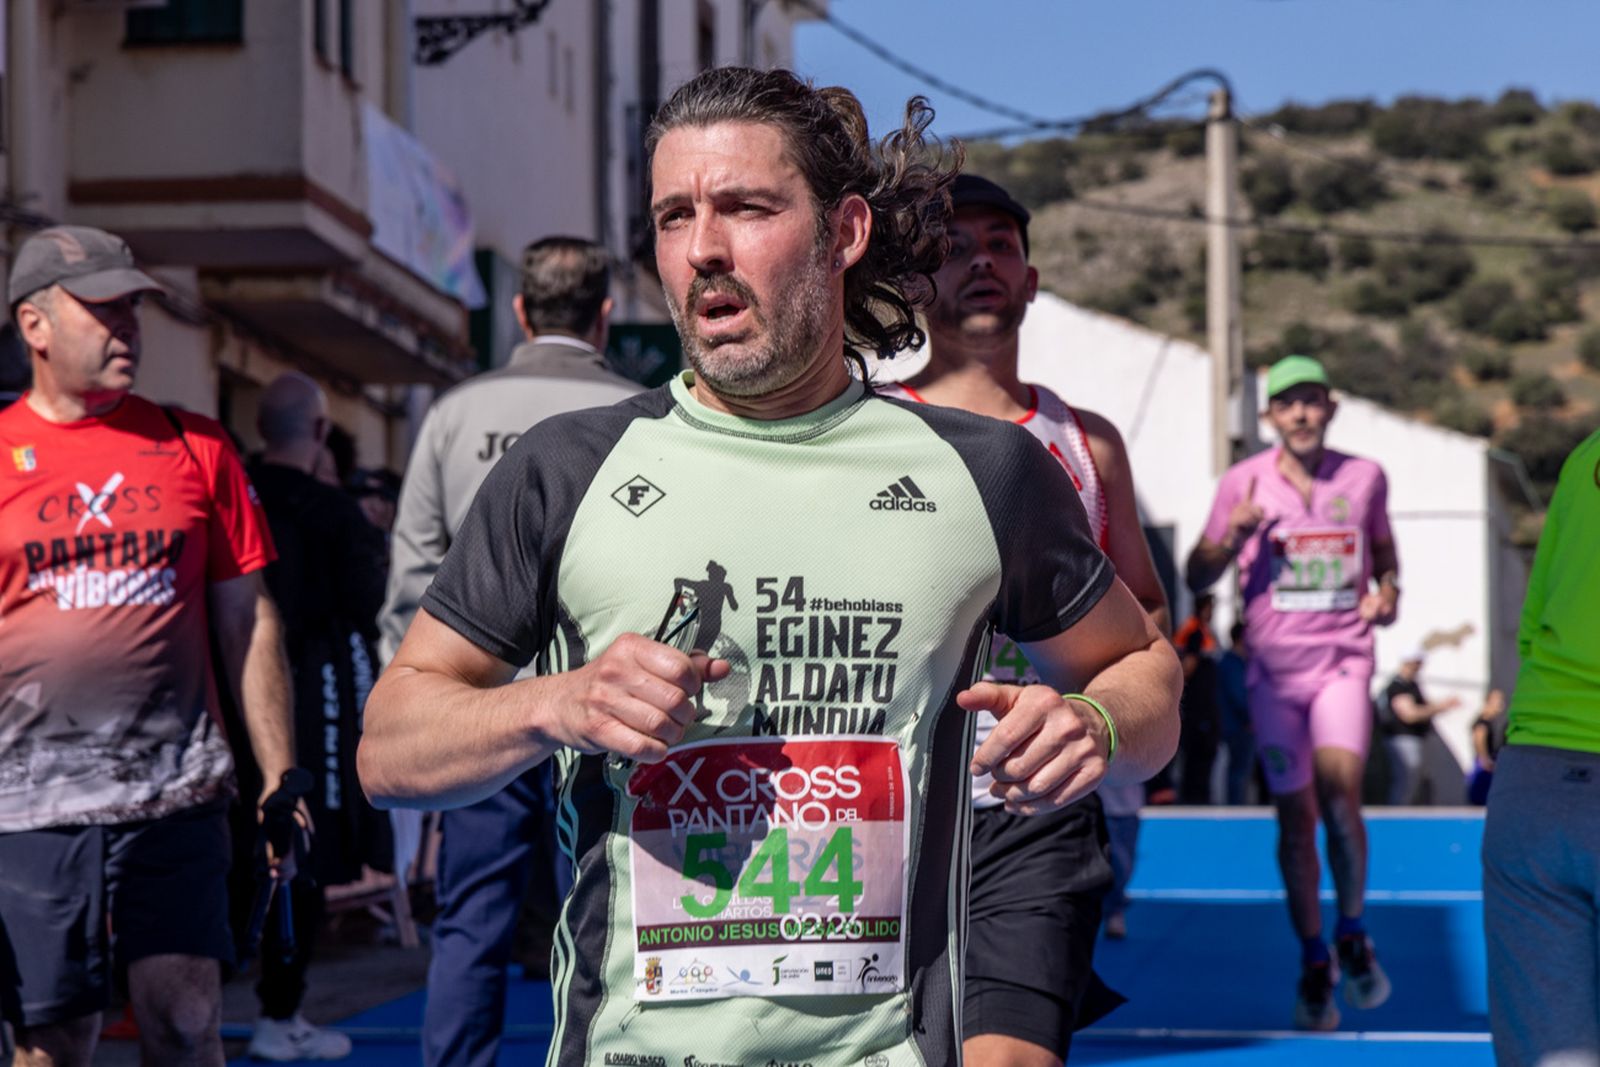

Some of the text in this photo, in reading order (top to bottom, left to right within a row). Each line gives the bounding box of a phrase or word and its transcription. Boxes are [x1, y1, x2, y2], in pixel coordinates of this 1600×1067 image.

[38, 485, 161, 523] CROSS
[625, 486, 649, 506] F
[869, 496, 937, 513] adidas
[24, 529, 187, 574] PANTANO
[756, 576, 903, 614] 54 #behobiass
[756, 616, 903, 659] EGINEZ
[984, 641, 1031, 677] 4
[754, 663, 897, 704] ALDATU
[666, 757, 861, 805] X CROSS
[667, 802, 862, 838] PANTANO DEL
[679, 826, 864, 919] 544
[639, 925, 714, 945] ANTONIO
[718, 920, 780, 941] JESUS
